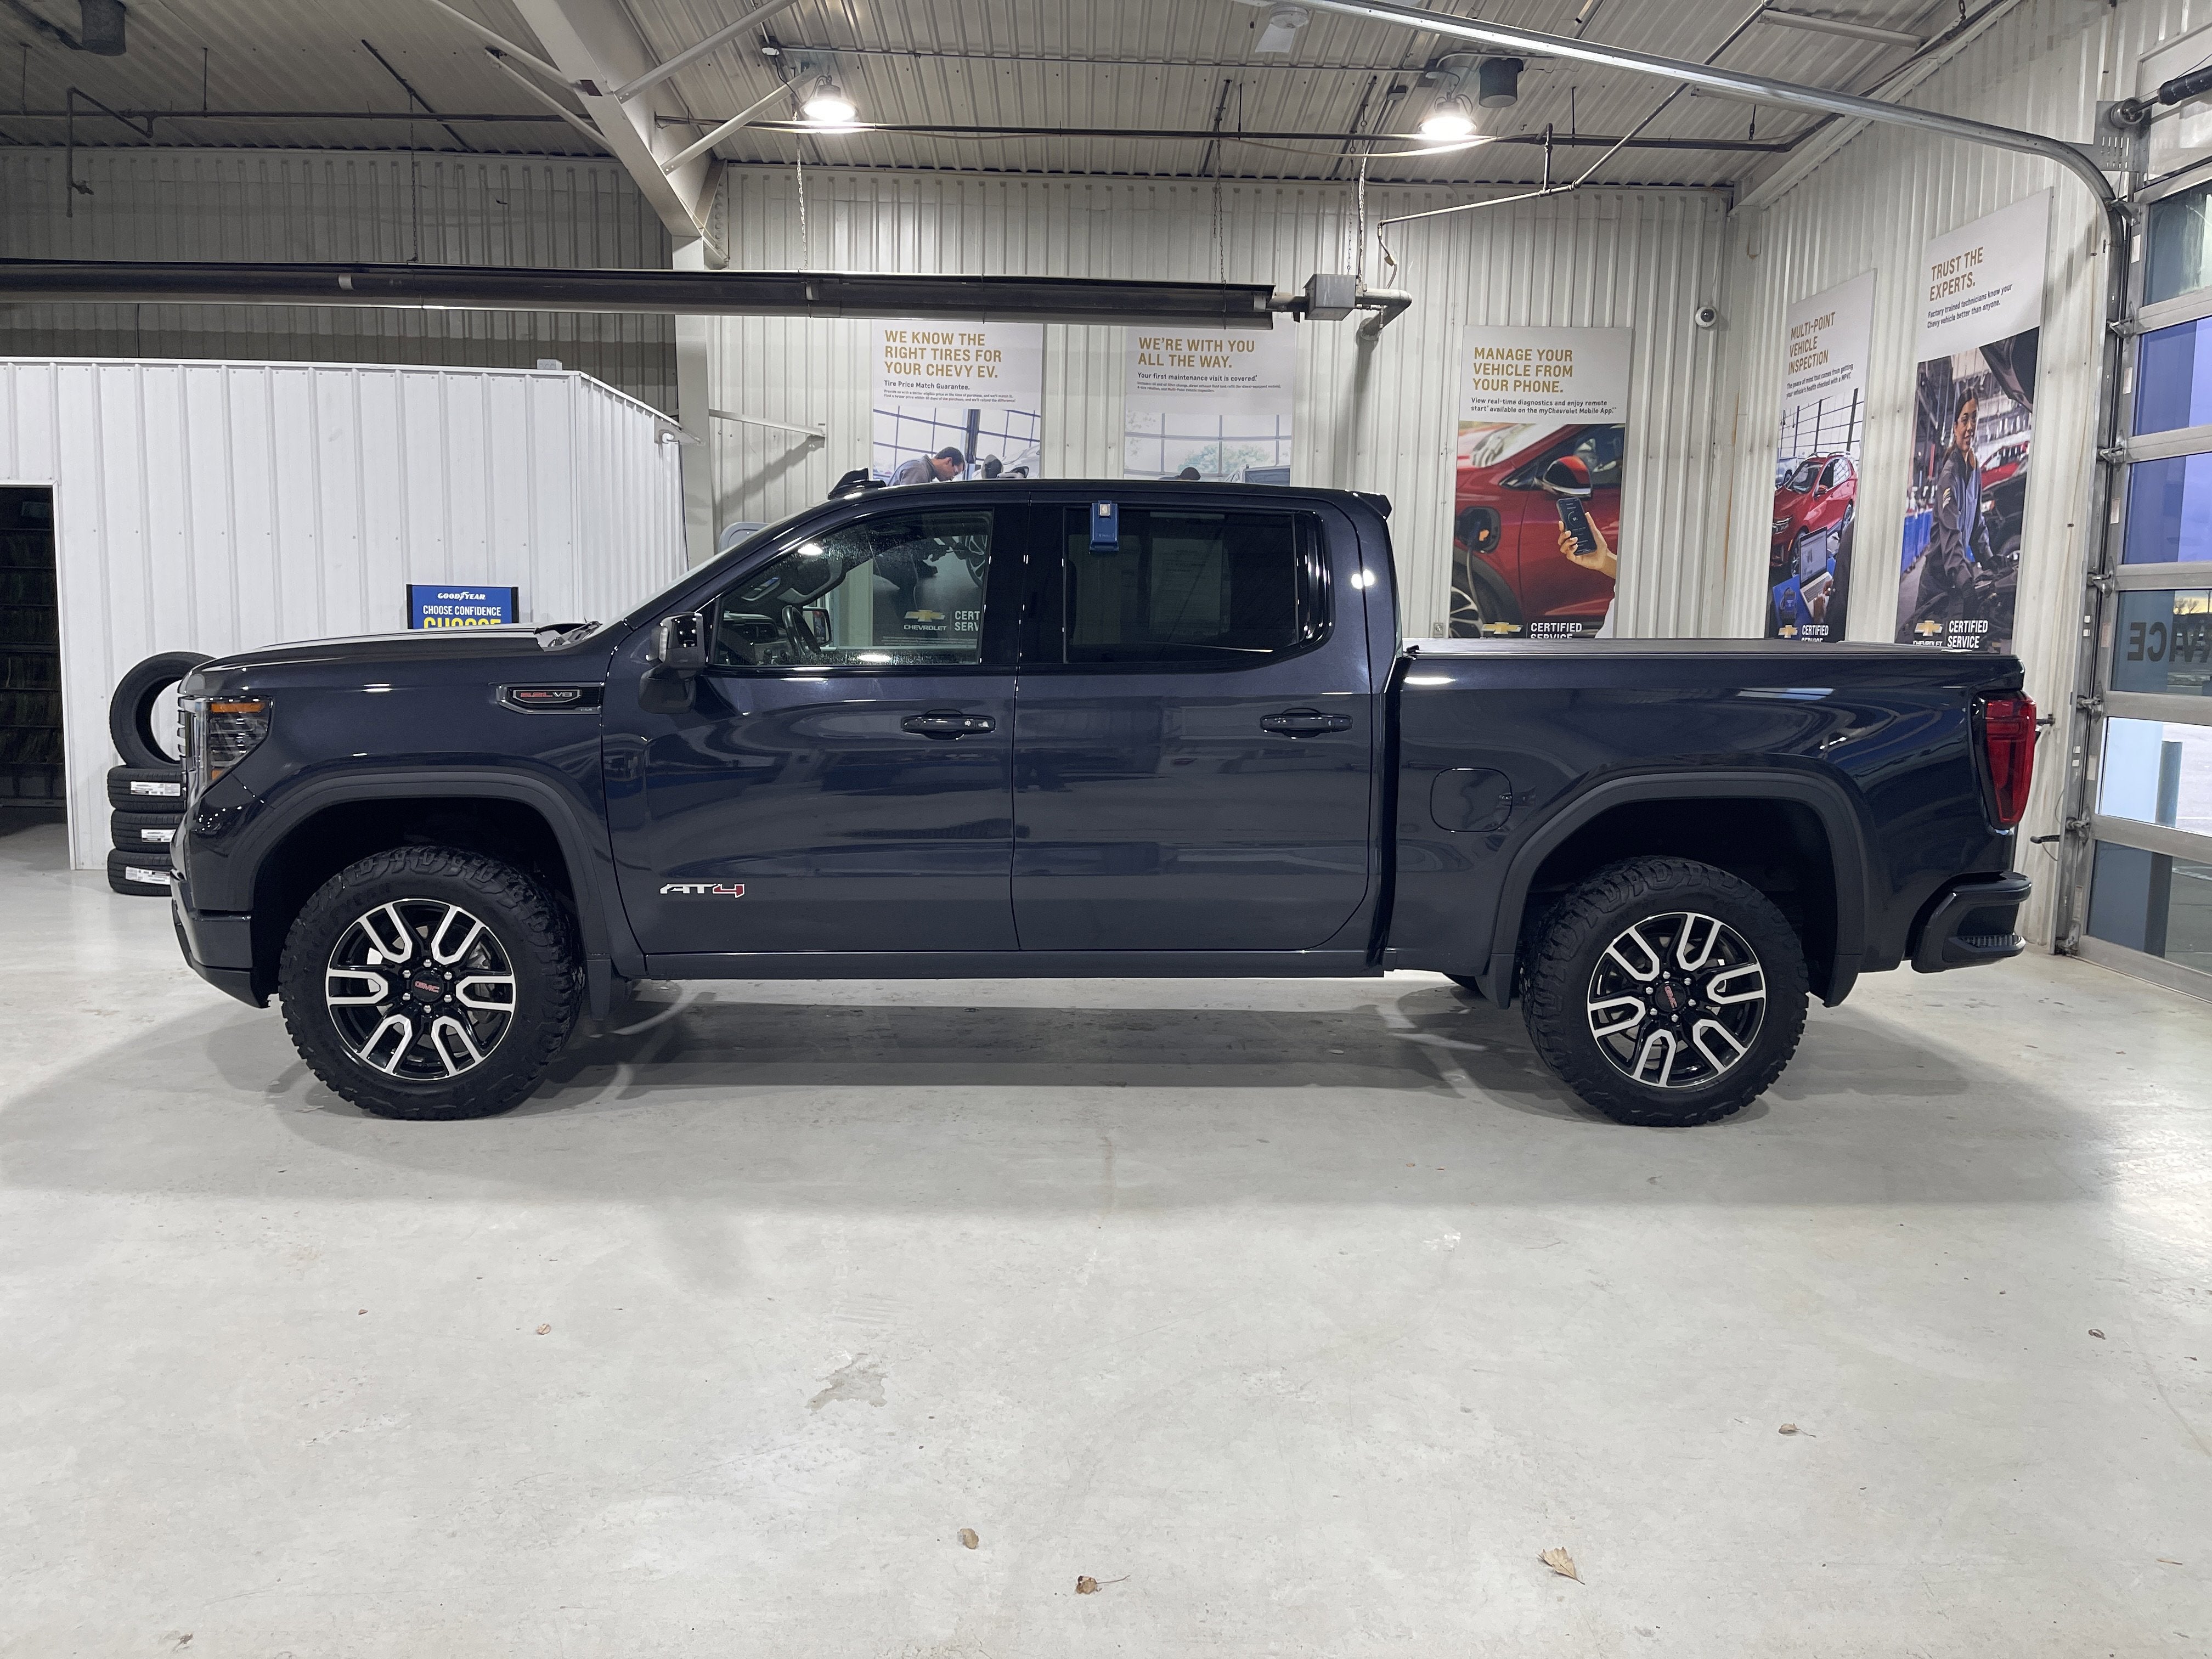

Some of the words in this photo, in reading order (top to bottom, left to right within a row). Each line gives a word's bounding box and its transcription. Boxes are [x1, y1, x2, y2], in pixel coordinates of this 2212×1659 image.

[1931, 256, 1961, 281] TRUST
[1964, 247, 1984, 268] THE
[1929, 272, 1976, 302] EXPERTS.
[1928, 307, 1944, 318] Factory
[1945, 301, 1960, 313] trained
[1961, 293, 1987, 308] technicians
[1988, 287, 2000, 298] know
[2001, 284, 2013, 295] your
[1927, 319, 1940, 329] Chevy
[1940, 313, 1955, 325] vehicle
[1956, 309, 1970, 319] better
[1971, 304, 1982, 315] than
[1982, 300, 2001, 311] anyone.
[1791, 312, 1836, 341] MULTI-POINT
[885, 330, 907, 343] WE
[912, 331, 954, 345] KNOW
[958, 334, 985, 346] THE
[1139, 337, 1182, 351] WE'RE
[1187, 340, 1222, 352] WITH
[1228, 340, 1255, 353] YOU
[885, 346, 926, 359] RIGHT
[931, 348, 970, 362] TIRES
[975, 349, 1001, 362] FOR
[1790, 336, 1818, 357] VEHICLE
[1138, 353, 1164, 366] ALL
[1169, 354, 1195, 367] THE
[1200, 356, 1232, 368] WAY.
[1474, 347, 1532, 360] MANAGE
[1537, 349, 1572, 362] YOUR
[1788, 349, 1829, 375] INSPECTION
[885, 362, 921, 375] YOUR
[926, 364, 973, 377] CHEVY
[978, 366, 998, 378] EV.
[1474, 363, 1531, 376] VEHICLE
[1536, 365, 1573, 377] FROM
[1472, 378, 1508, 392] YOUR
[1514, 380, 1564, 392] PHONE.
[437, 591, 486, 601] GOODYEAR
[423, 605, 453, 615] CHOOSE
[454, 606, 501, 616] CONFIDENCE
[1531, 623, 1582, 632] CERTIFIED
[1802, 625, 1829, 635] CERTIFIED
[1949, 620, 1988, 633] CERTIFIED
[1947, 635, 1980, 648] SERVICE
[660, 883, 744, 898] AT4
[415, 981, 439, 993] GMC
[1664, 986, 1677, 1008] GMC
